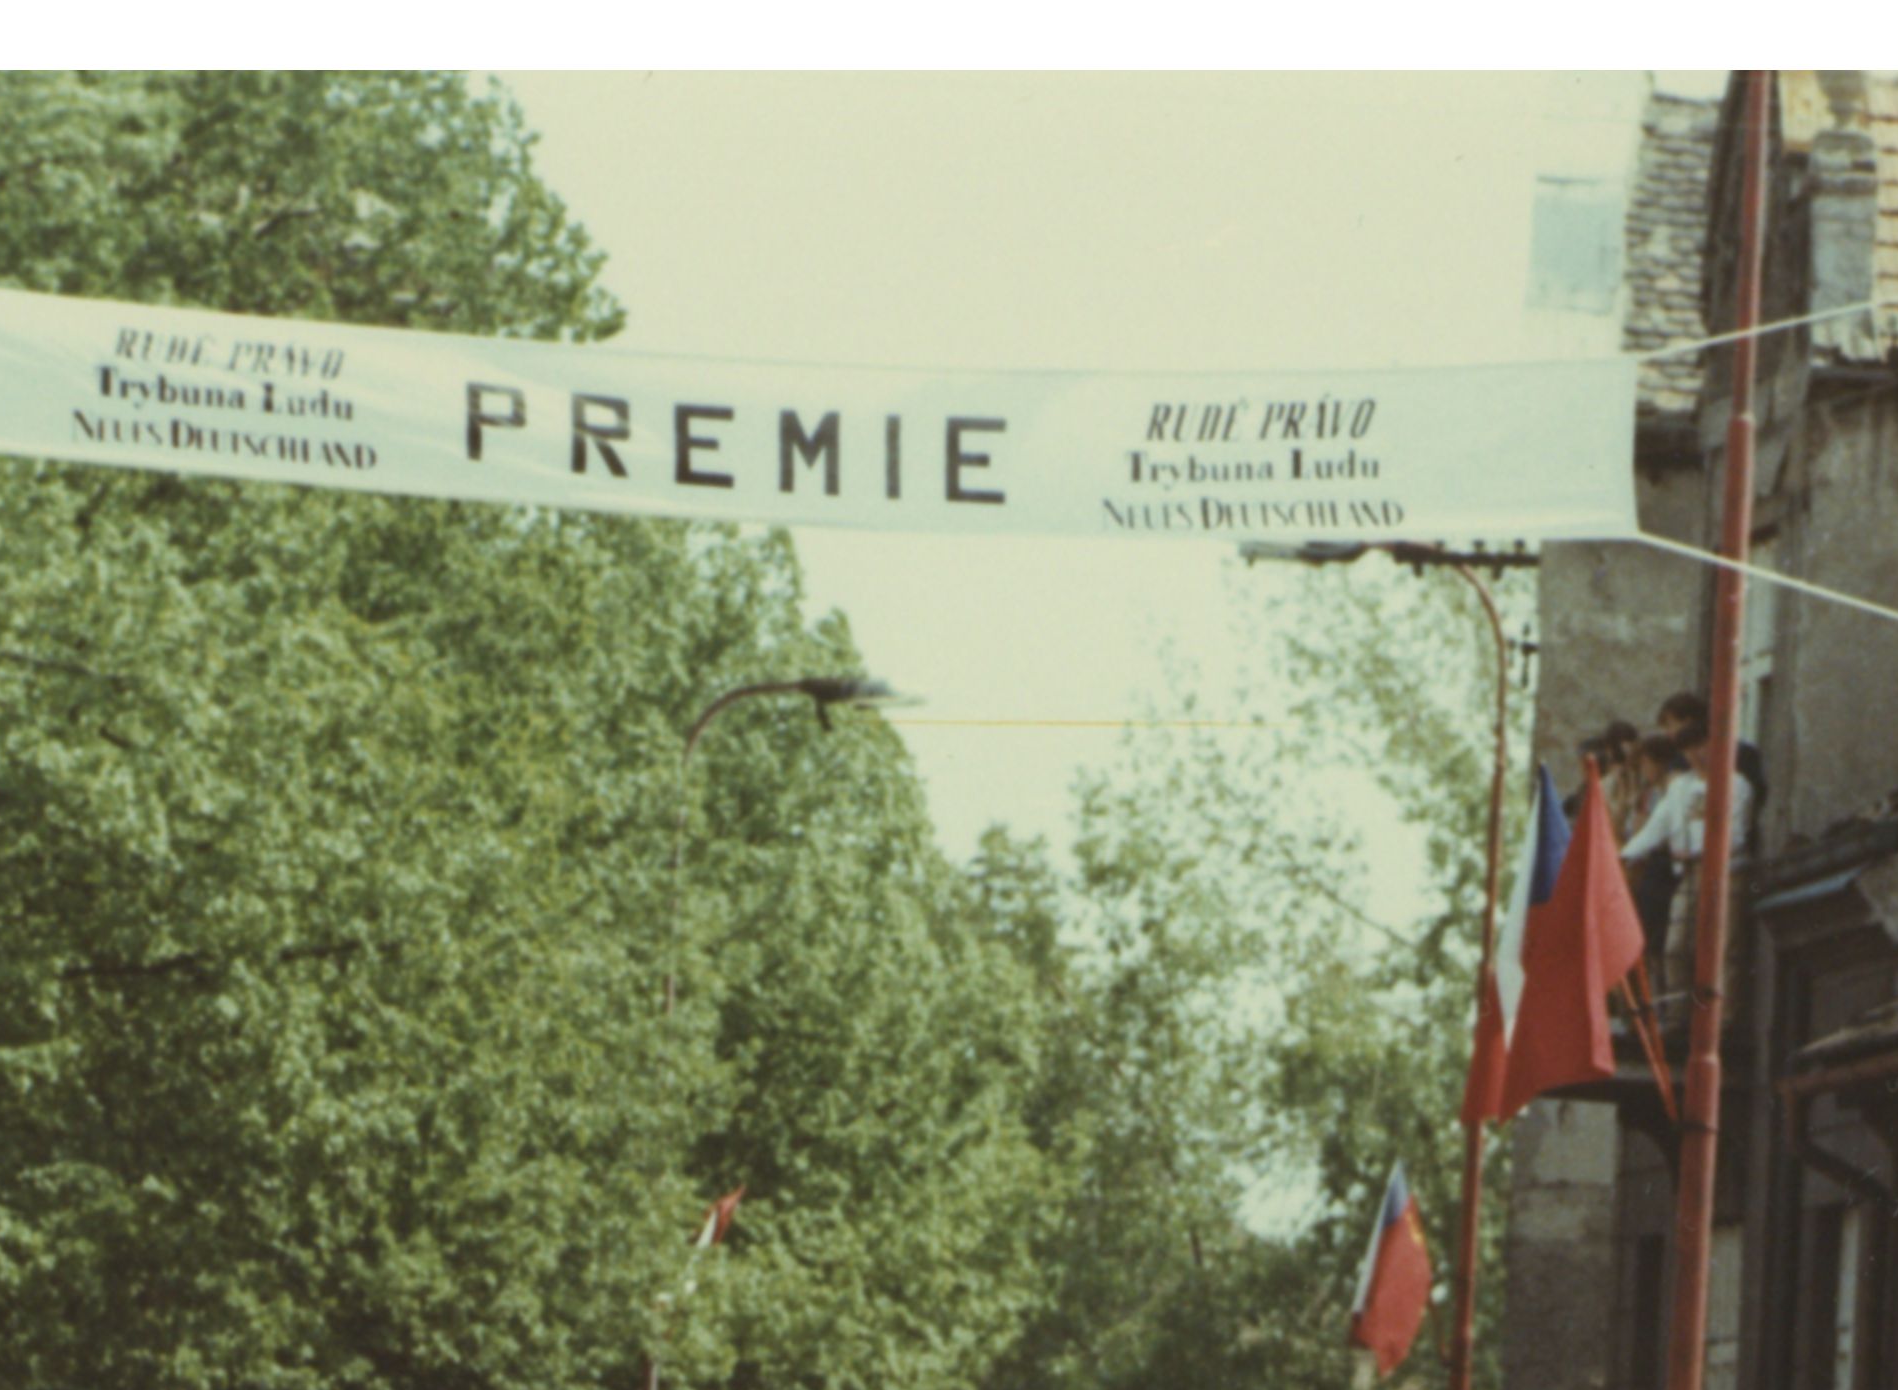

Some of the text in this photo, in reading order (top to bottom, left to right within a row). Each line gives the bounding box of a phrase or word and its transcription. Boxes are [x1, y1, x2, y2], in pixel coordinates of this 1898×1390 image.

[96, 364, 354, 422] Trybuna Ludu
[466, 381, 1007, 505] PREMIE
[1128, 448, 1380, 491] Trybuna Ludu
